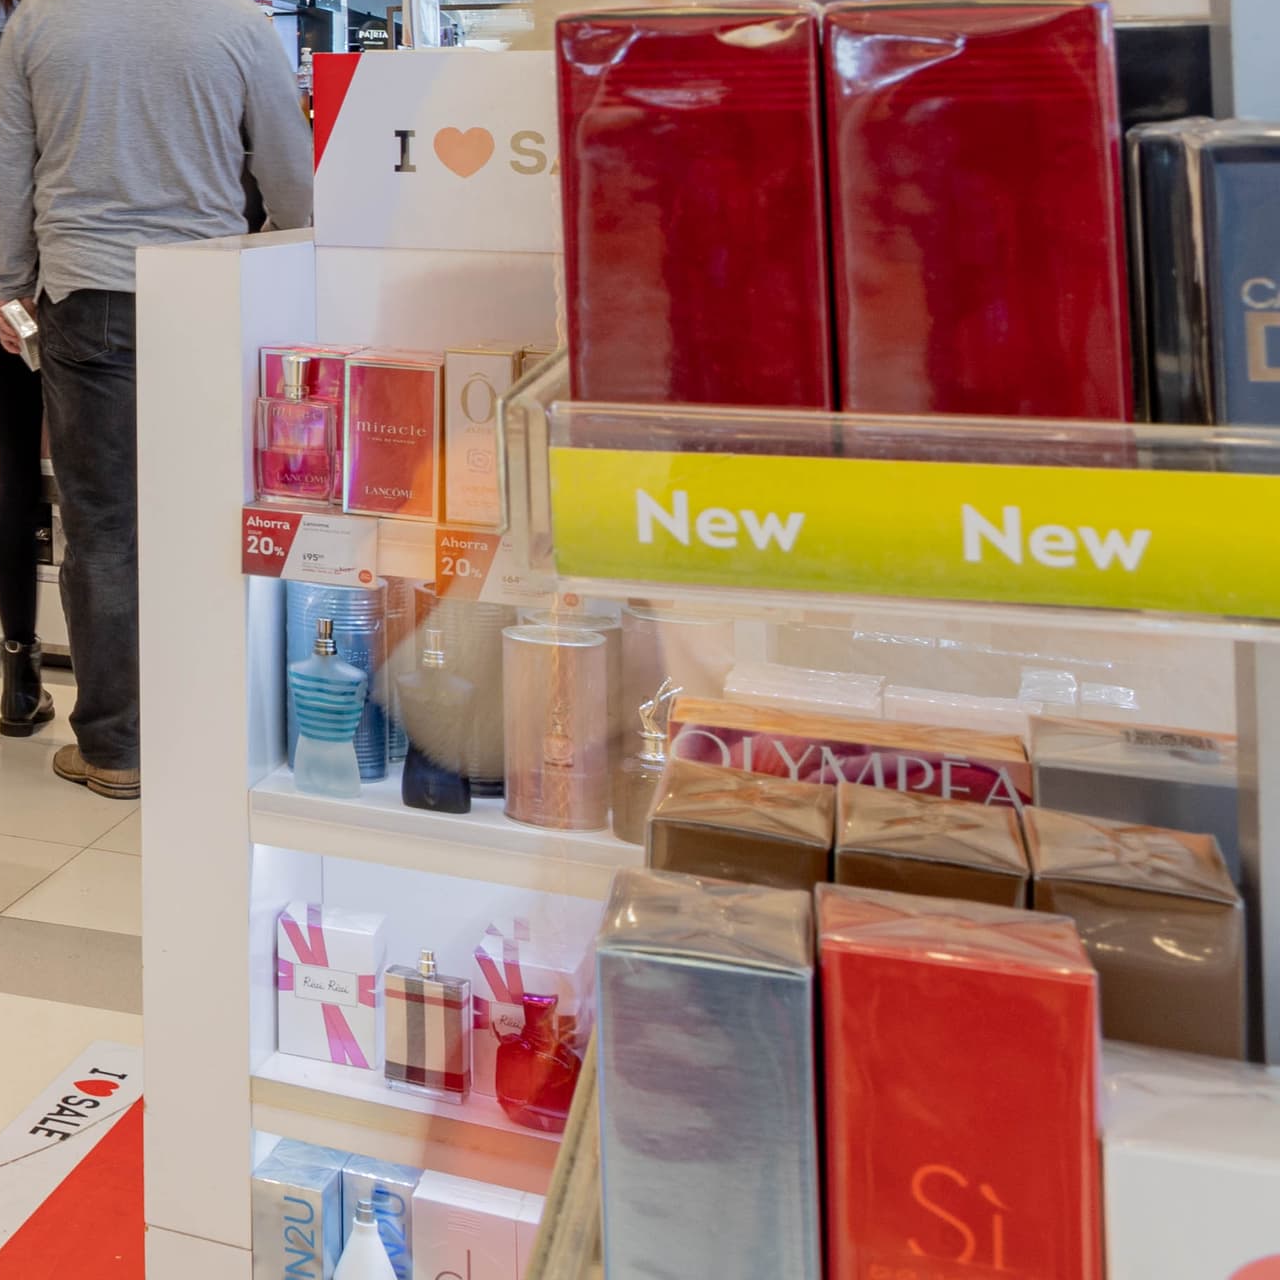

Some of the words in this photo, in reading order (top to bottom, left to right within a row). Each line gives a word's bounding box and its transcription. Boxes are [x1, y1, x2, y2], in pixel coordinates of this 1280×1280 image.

[358, 29, 388, 40] PATRIA
[393, 130, 417, 173] I
[356, 420, 427, 437] miracle
[246, 516, 290, 530] Ahorra
[635, 489, 805, 553] New
[960, 503, 1152, 572] New
[247, 535, 285, 557] 20%
[440, 537, 488, 551] Ahorra
[440, 557, 482, 579] 20%
[89, 1067, 128, 1080] I
[28, 1095, 101, 1141] SALE
